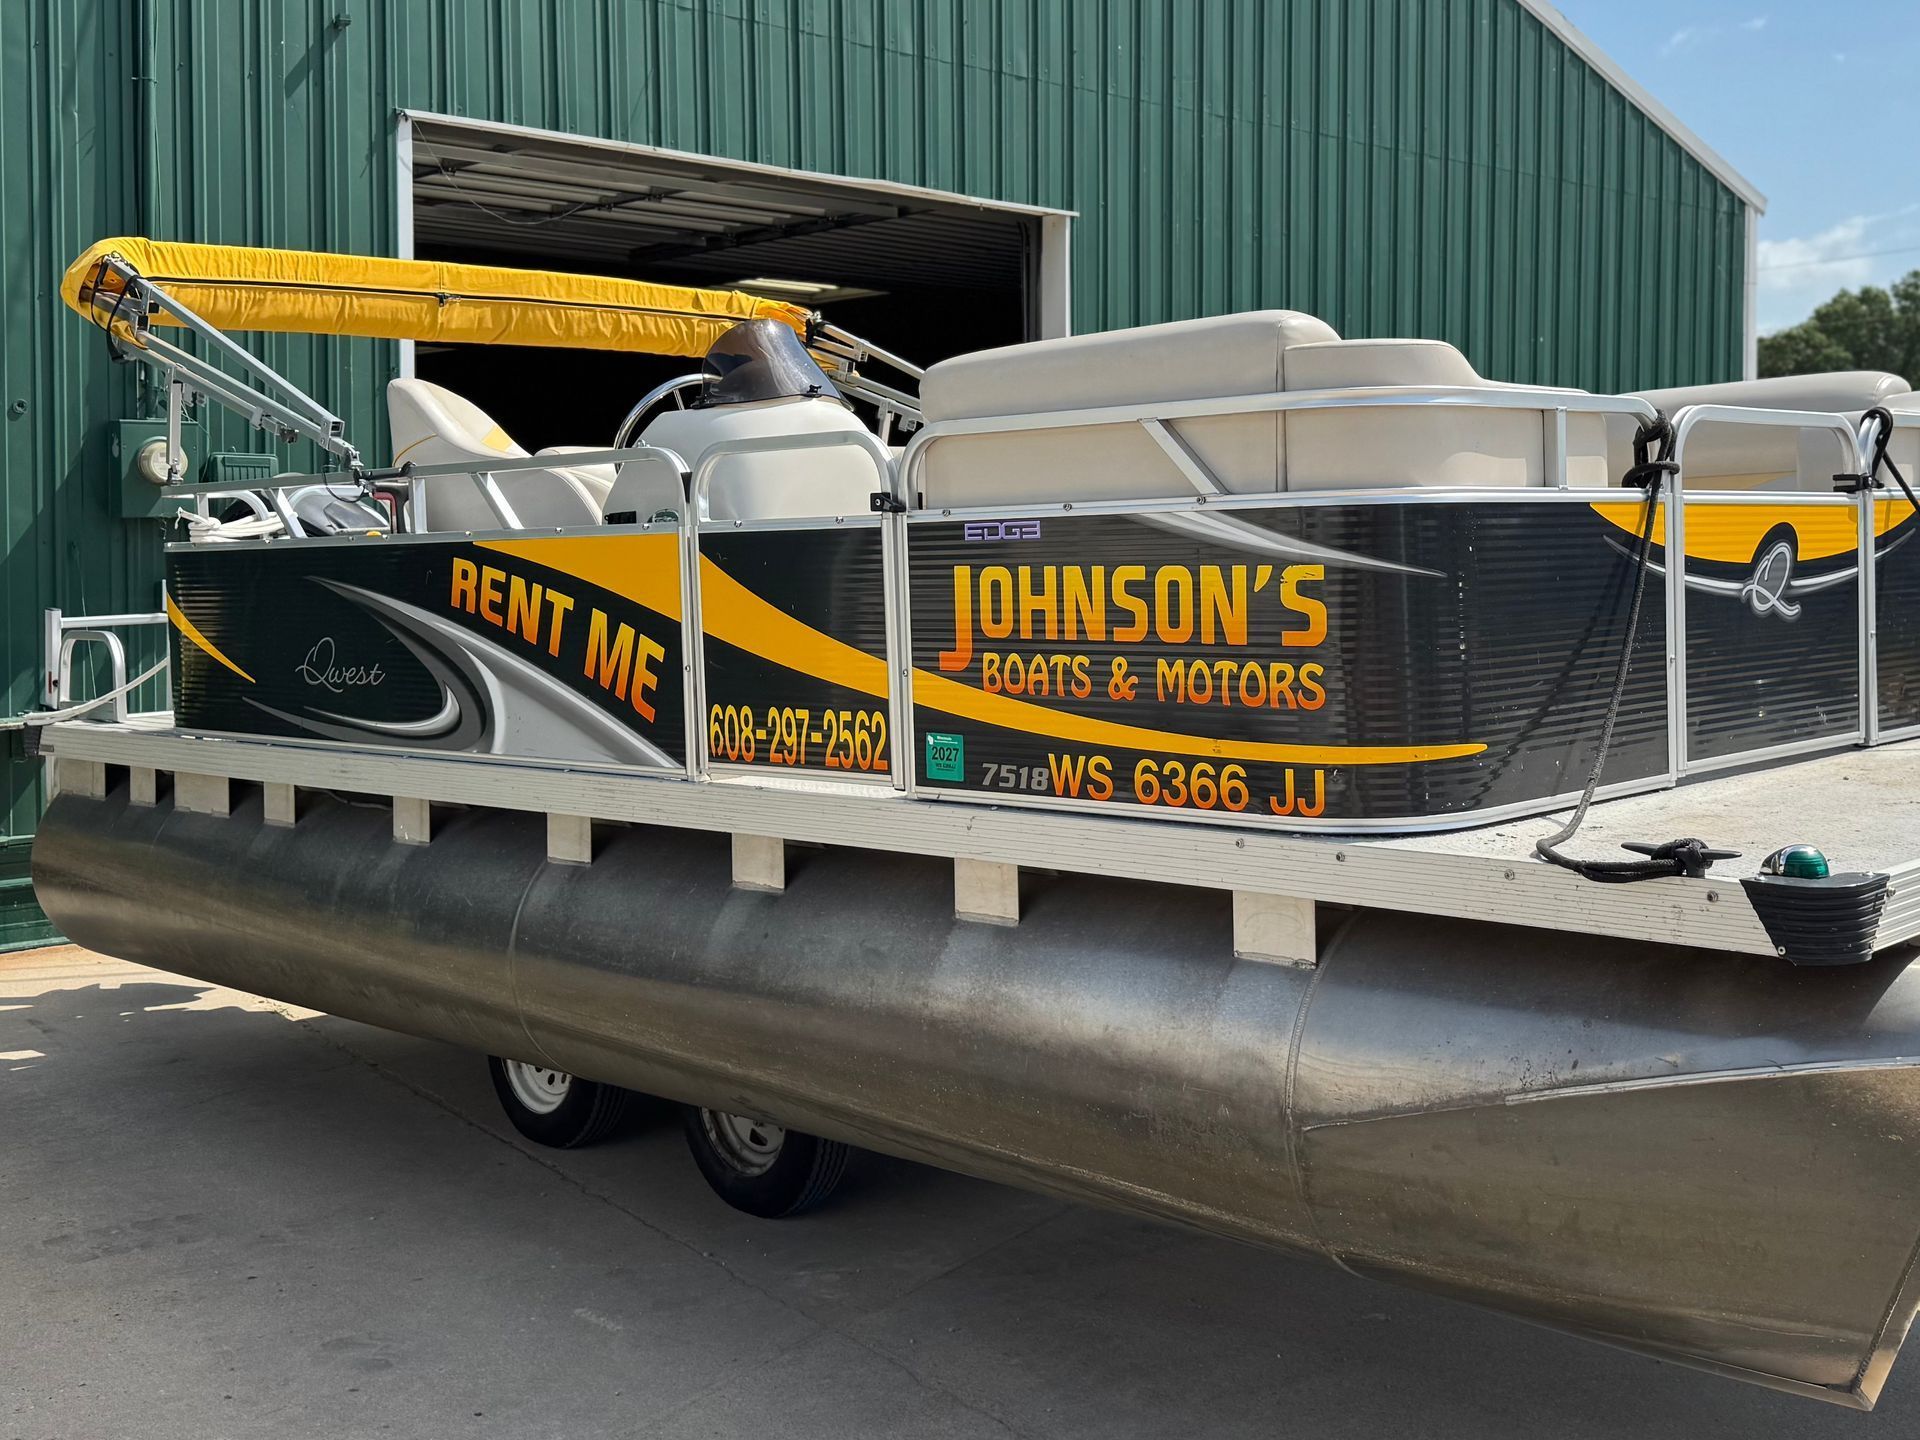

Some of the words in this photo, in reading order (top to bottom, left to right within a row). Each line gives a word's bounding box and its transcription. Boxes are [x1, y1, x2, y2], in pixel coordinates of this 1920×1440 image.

[450, 557, 574, 657] RENT
[584, 608, 665, 724] ME
[939, 564, 1328, 671] JOHNSON'S
[295, 636, 386, 693] Qwest
[982, 652, 1092, 699] BOATS
[1108, 656, 1138, 701] &
[1156, 658, 1326, 711] MOTORS
[709, 703, 888, 770] 608-297-2562
[931, 746, 960, 762] 2027
[981, 762, 1049, 791] 7518
[1048, 753, 1114, 801] WS
[1133, 758, 1249, 812] 6366
[1269, 768, 1325, 817] JJ
